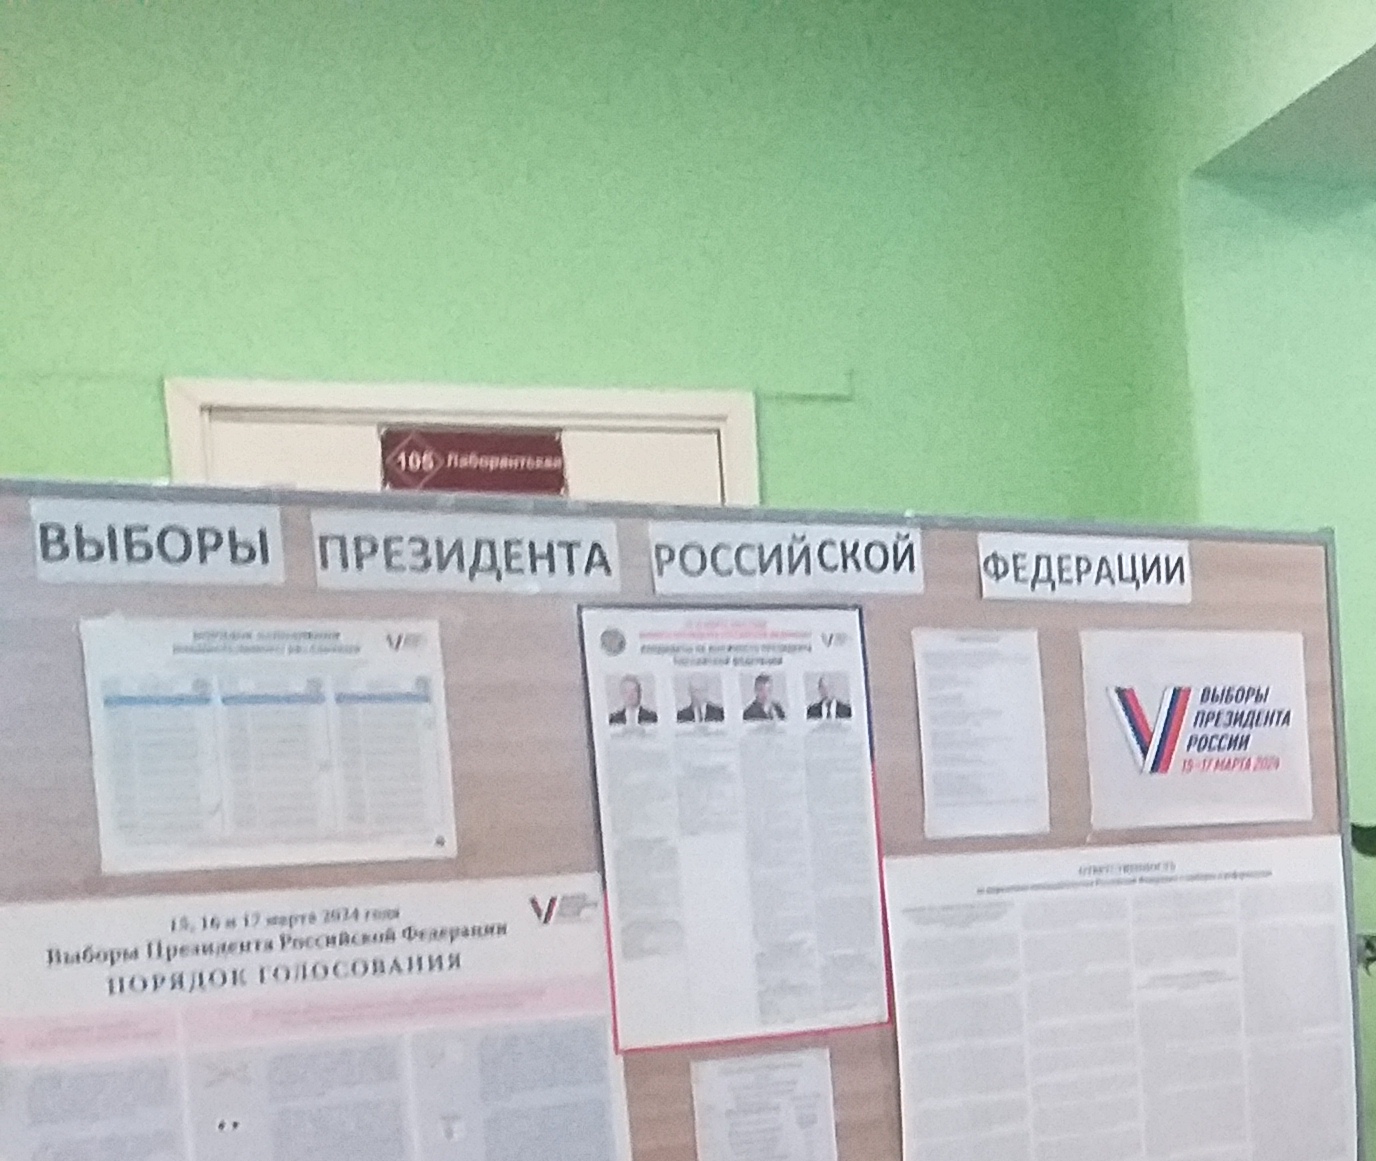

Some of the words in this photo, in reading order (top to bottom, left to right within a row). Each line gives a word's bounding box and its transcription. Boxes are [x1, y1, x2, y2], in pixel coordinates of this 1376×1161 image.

[38, 522, 271, 567] ВЫБОРЫ
[317, 533, 612, 582] ПРЕЗИДЕНТА
[654, 533, 917, 578] РОССИЙСКОЙ
[982, 550, 1186, 592] ФЕДЕРАЦИИ
[1200, 686, 1270, 704] ВЫБОРЫ
[1193, 709, 1292, 730] ПРЕЗИДЕНТА
[1187, 734, 1250, 752] РОССИИ
[46, 946, 140, 967] Выборы
[146, 940, 274, 961] Президента
[279, 924, 397, 951] Российской
[402, 920, 509, 945] Федерации
[106, 971, 248, 996] ПОРЯДОК
[258, 953, 463, 984] ГОЛОСОВАНИЯ
